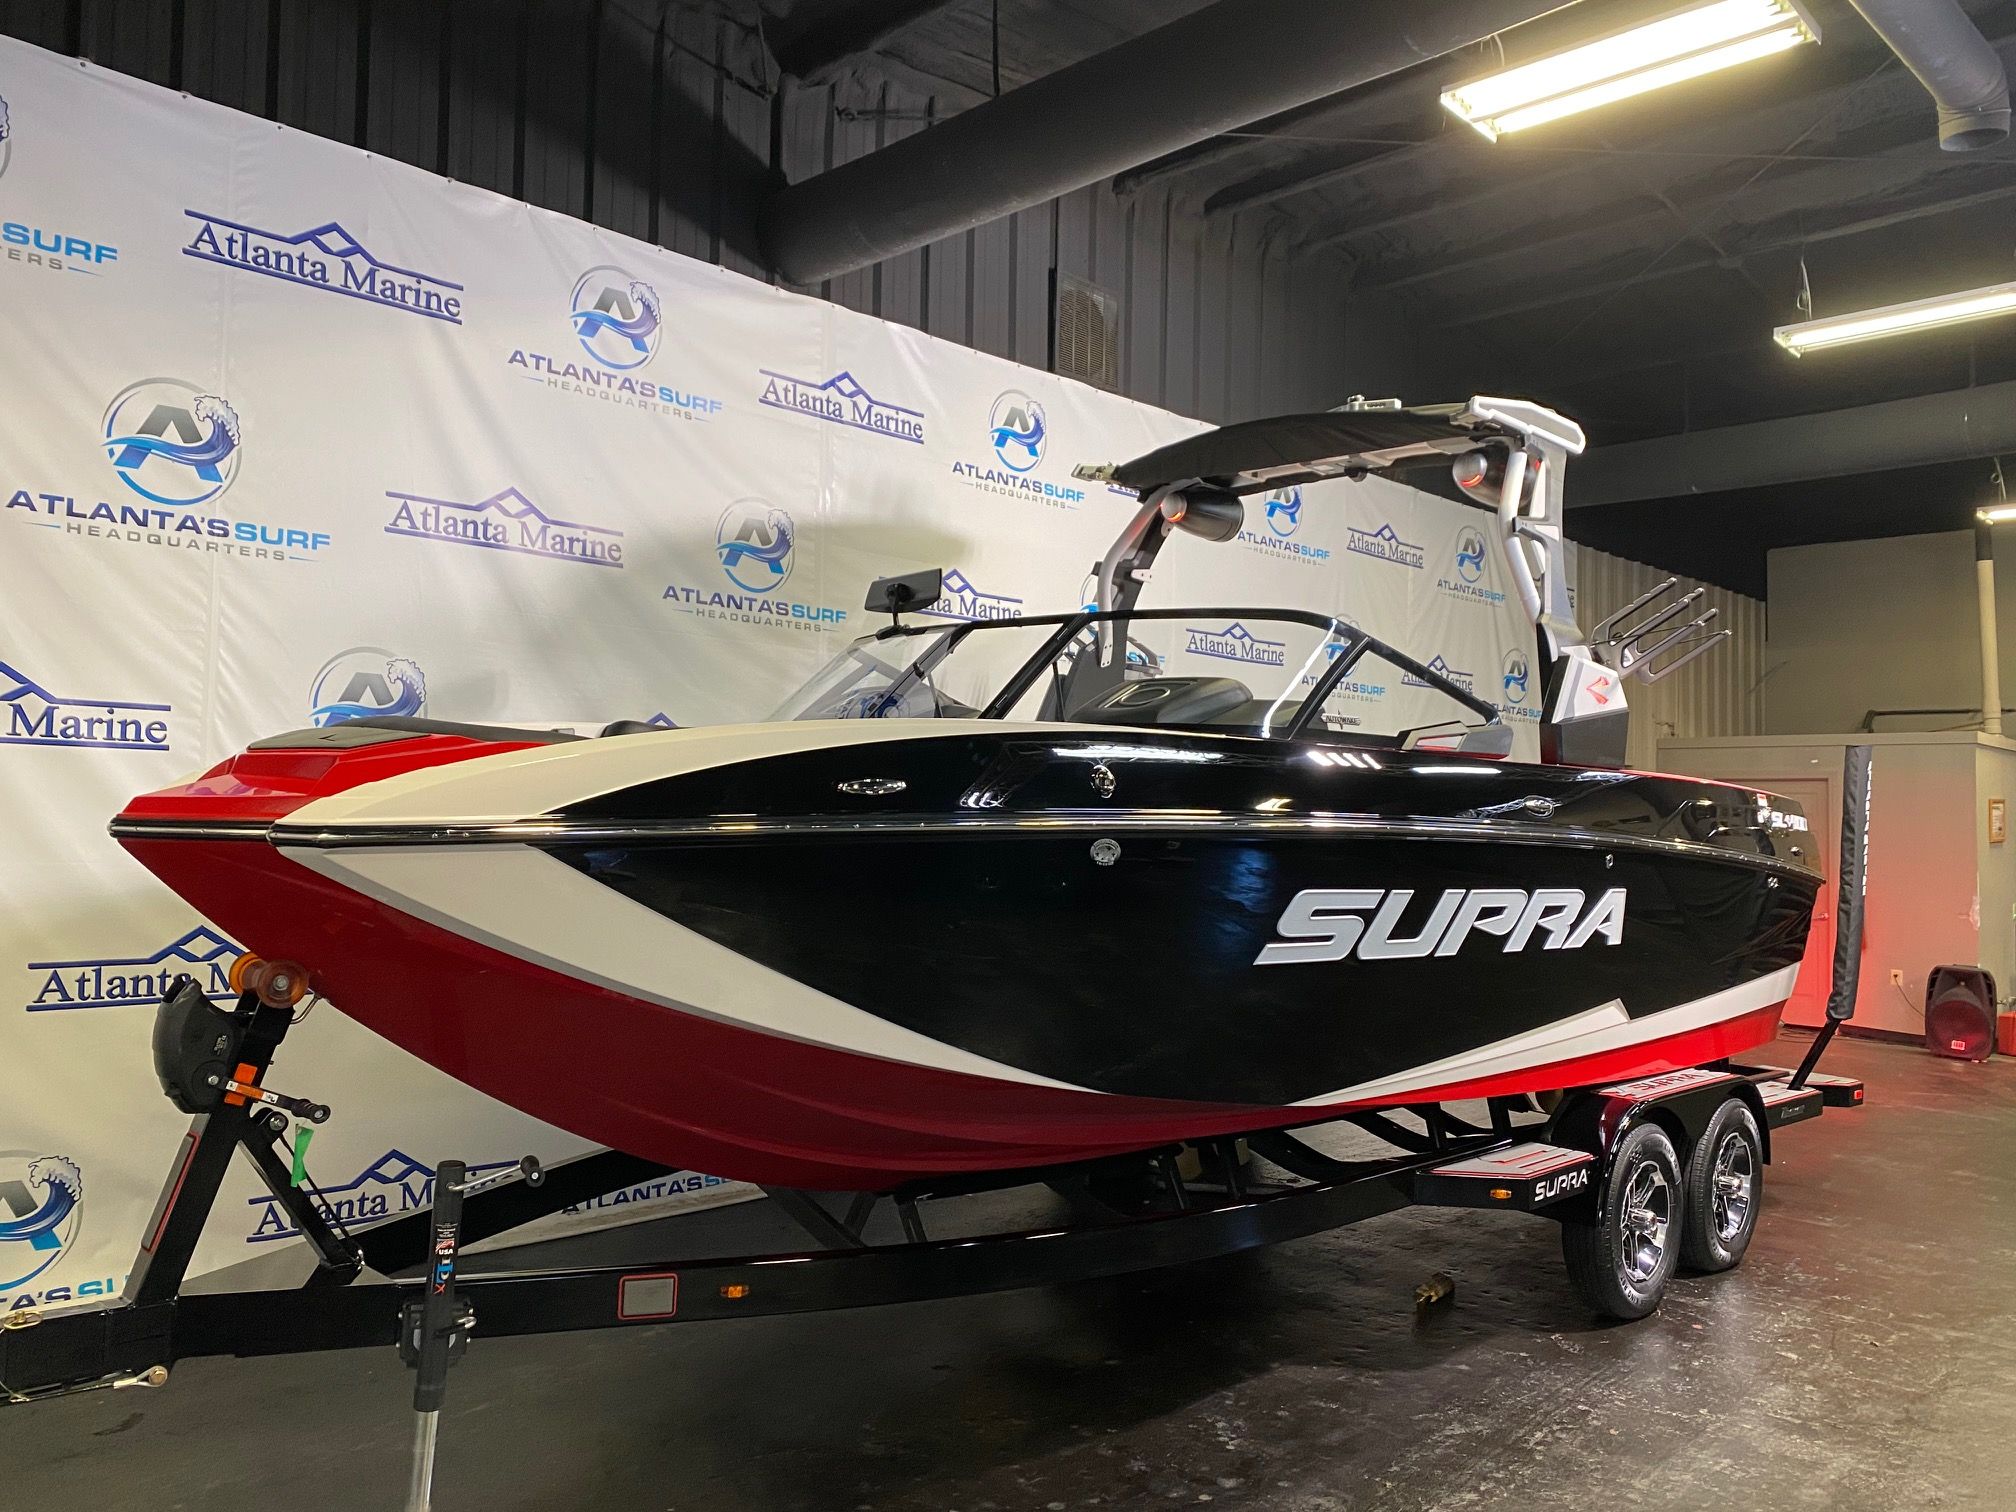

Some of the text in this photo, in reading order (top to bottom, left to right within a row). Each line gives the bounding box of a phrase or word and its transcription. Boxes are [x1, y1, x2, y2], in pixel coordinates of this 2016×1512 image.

[2, 222, 118, 264] SURF
[188, 222, 461, 317] Atlanta Marine
[548, 377, 692, 420] HEADQUARTERS
[762, 377, 923, 439] Atlanta Marine
[975, 482, 1066, 509] HEADQUARTERS
[67, 522, 285, 561] HEADQUARTERS
[389, 499, 622, 562] Atlanta Marine
[1348, 533, 1424, 566] Atlanta Marine
[696, 608, 822, 633] HEADQUARTERS
[1187, 633, 1284, 662] Atlanta Marine
[6, 703, 168, 744] Marine
[1253, 888, 1627, 966] SUPRA
[1534, 1168, 1588, 1202] SUPRA
